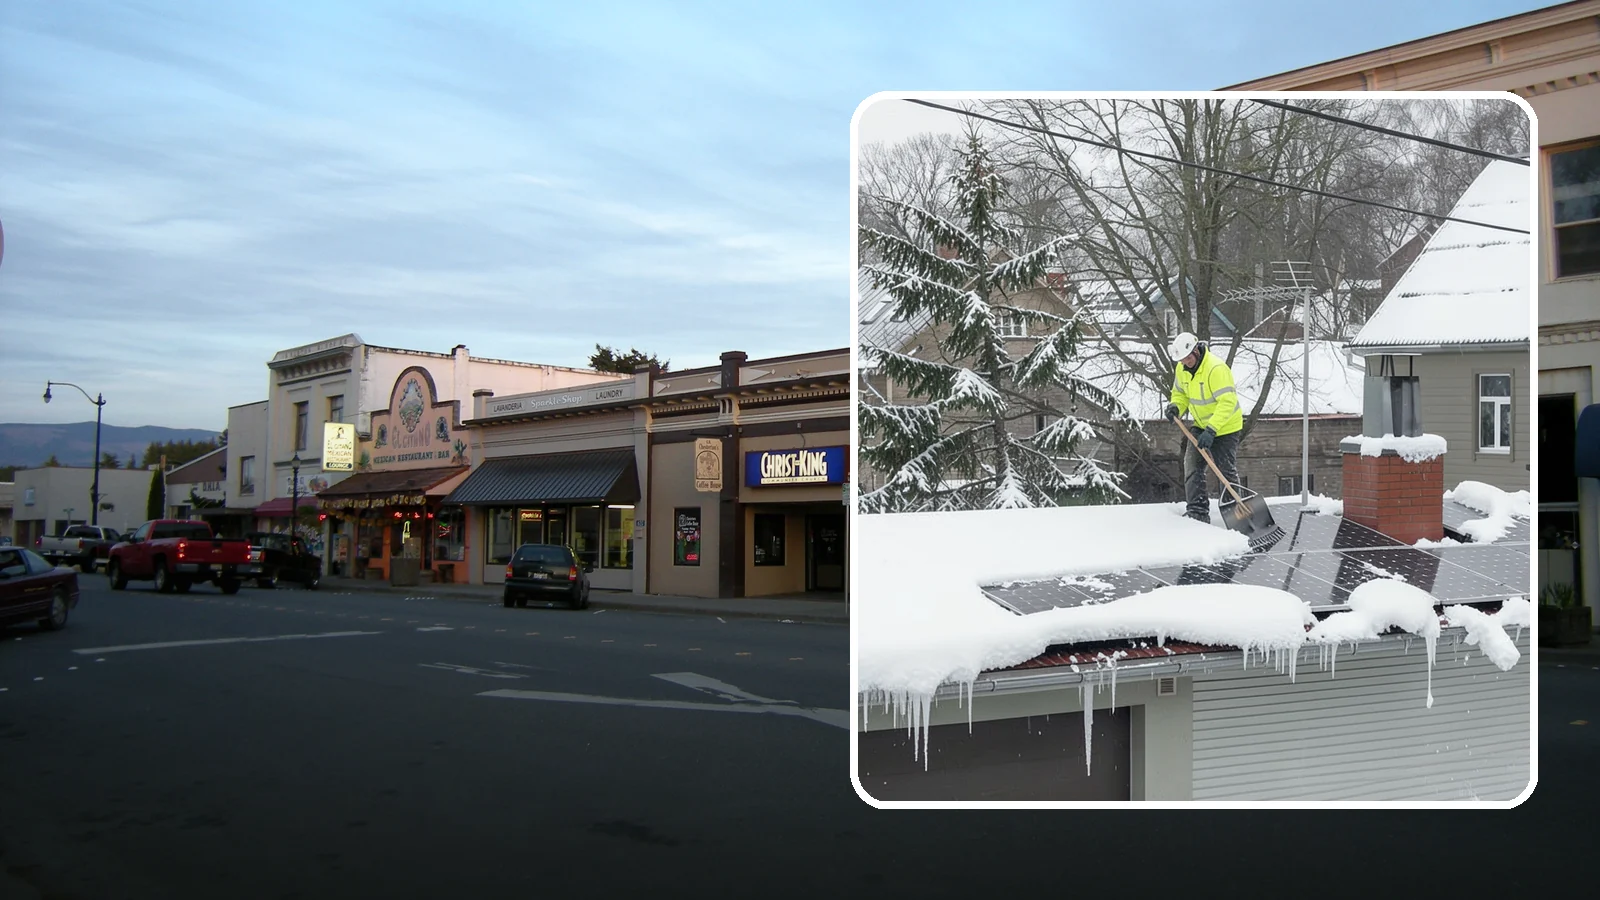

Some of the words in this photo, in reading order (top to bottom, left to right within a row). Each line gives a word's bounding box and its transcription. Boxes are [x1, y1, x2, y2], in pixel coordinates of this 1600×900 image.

[493, 402, 522, 413] LAVANDERIA
[561, 394, 583, 406] Shop
[595, 389, 624, 400] LAUNDRY
[373, 454, 396, 464] MEXICAN
[397, 451, 433, 462] RESTAURANT
[437, 450, 450, 459] BAR
[760, 452, 797, 478] CHRIST
[799, 450, 827, 476] KING
